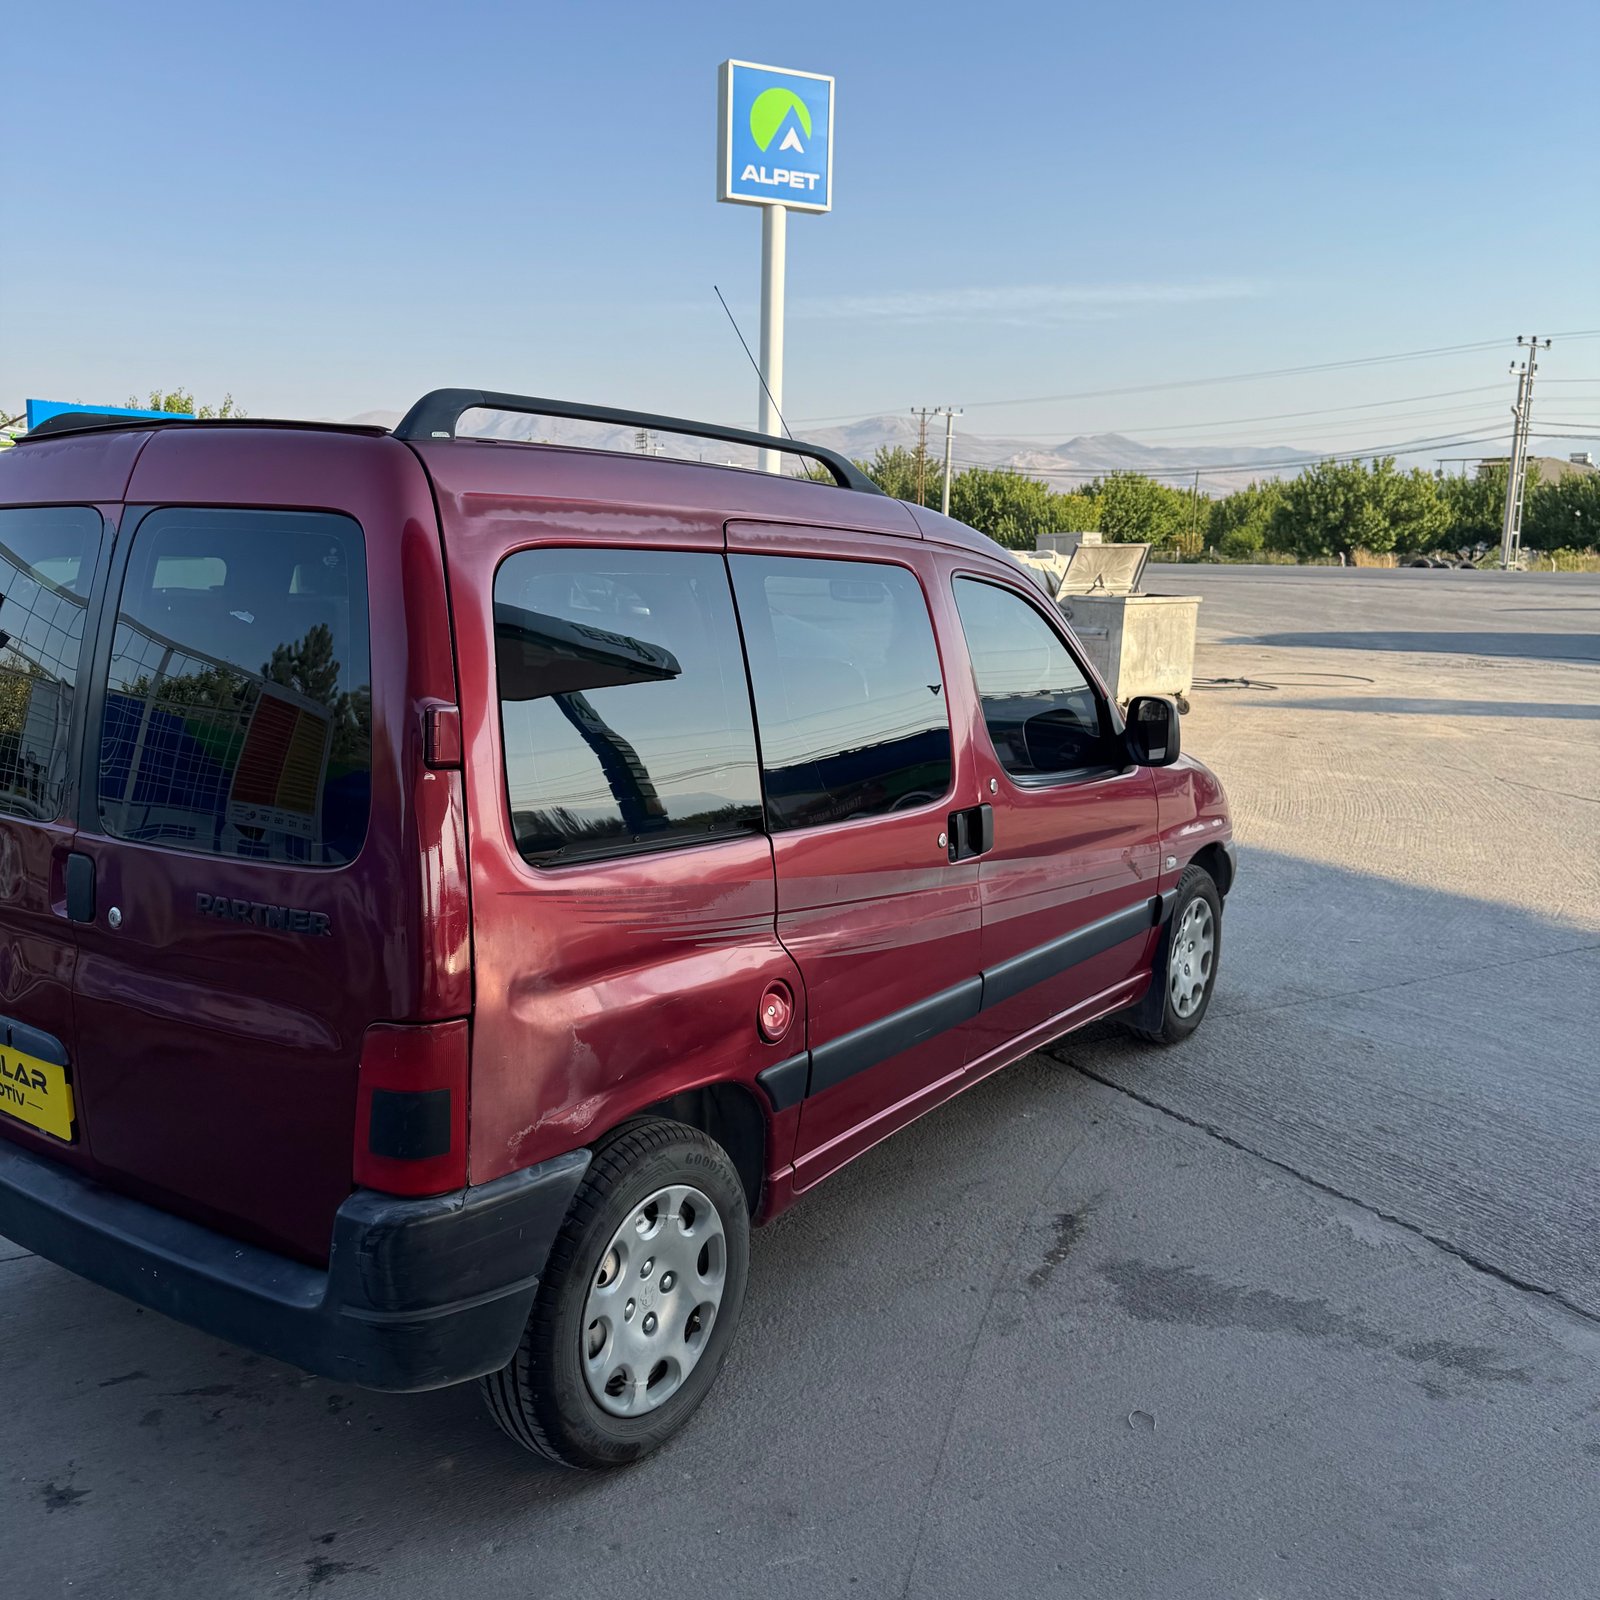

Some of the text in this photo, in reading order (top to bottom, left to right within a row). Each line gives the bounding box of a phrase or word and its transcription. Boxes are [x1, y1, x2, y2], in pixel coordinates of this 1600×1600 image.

[740, 164, 820, 190] ALPET
[196, 892, 333, 936] PARTNER
[0, 1054, 48, 1095] LAR
